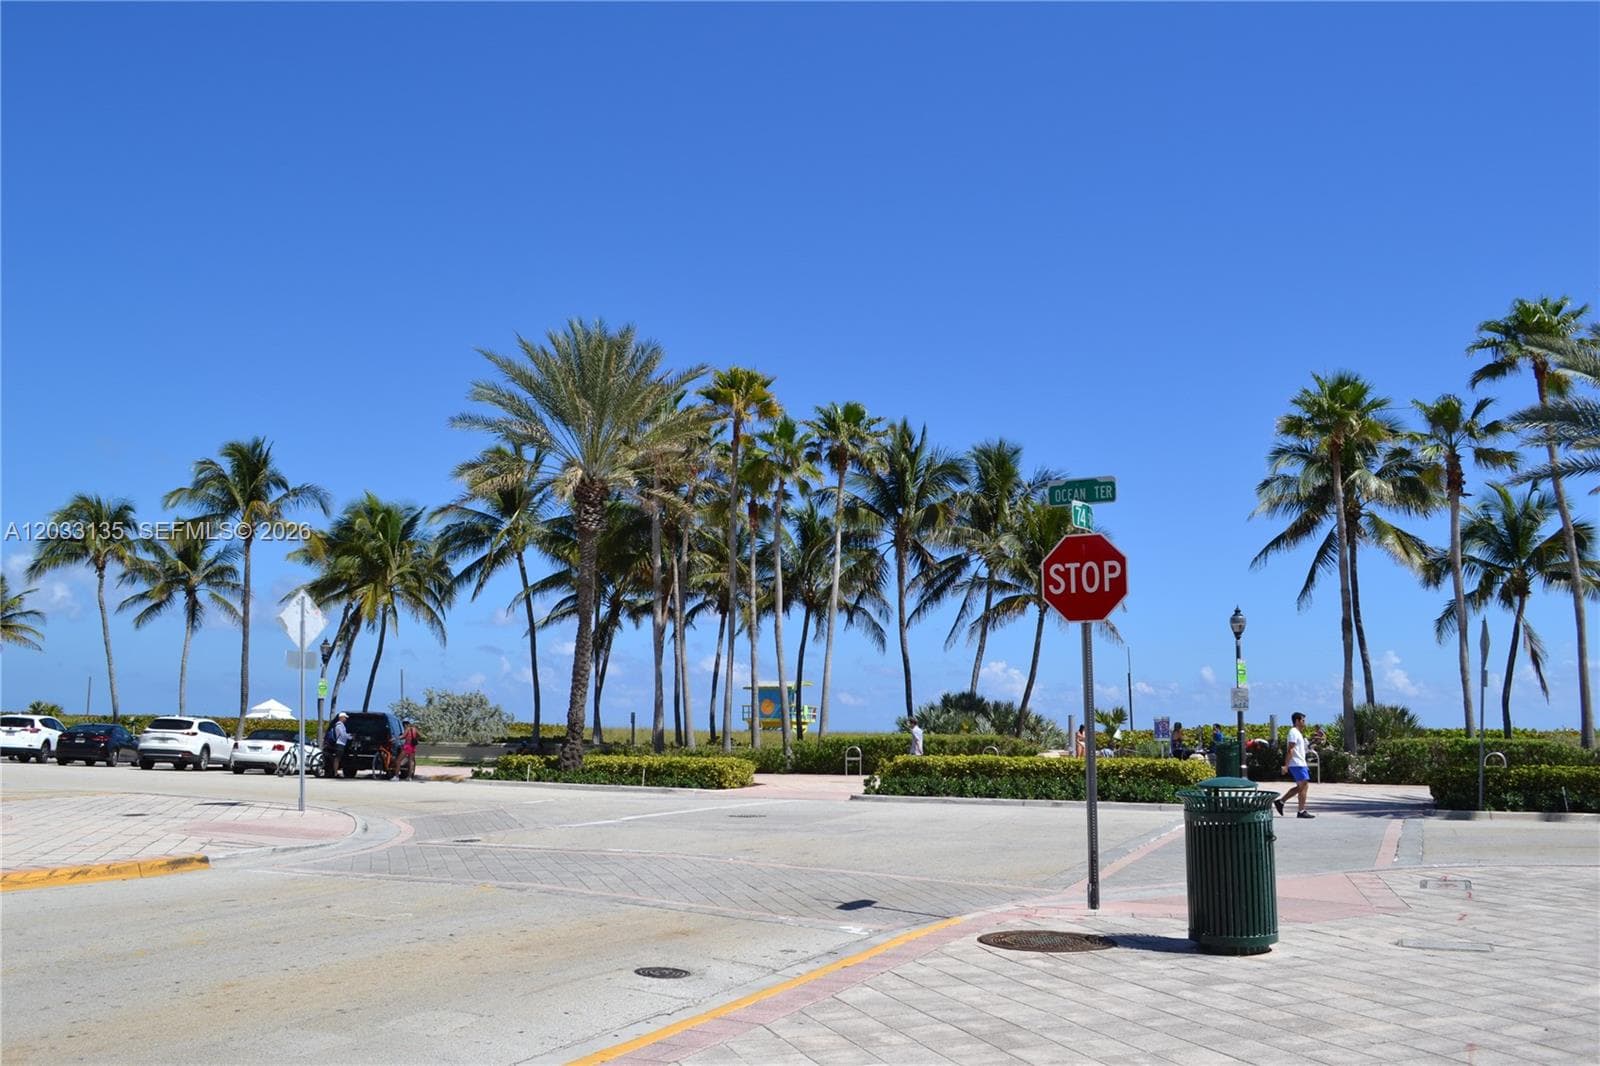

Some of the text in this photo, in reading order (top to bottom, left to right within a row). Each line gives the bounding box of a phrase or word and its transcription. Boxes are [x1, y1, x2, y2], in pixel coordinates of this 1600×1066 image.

[1054, 485, 1113, 502] OCEAN TER
[1076, 506, 1086, 527] 74
[1048, 560, 1122, 595] STOP
